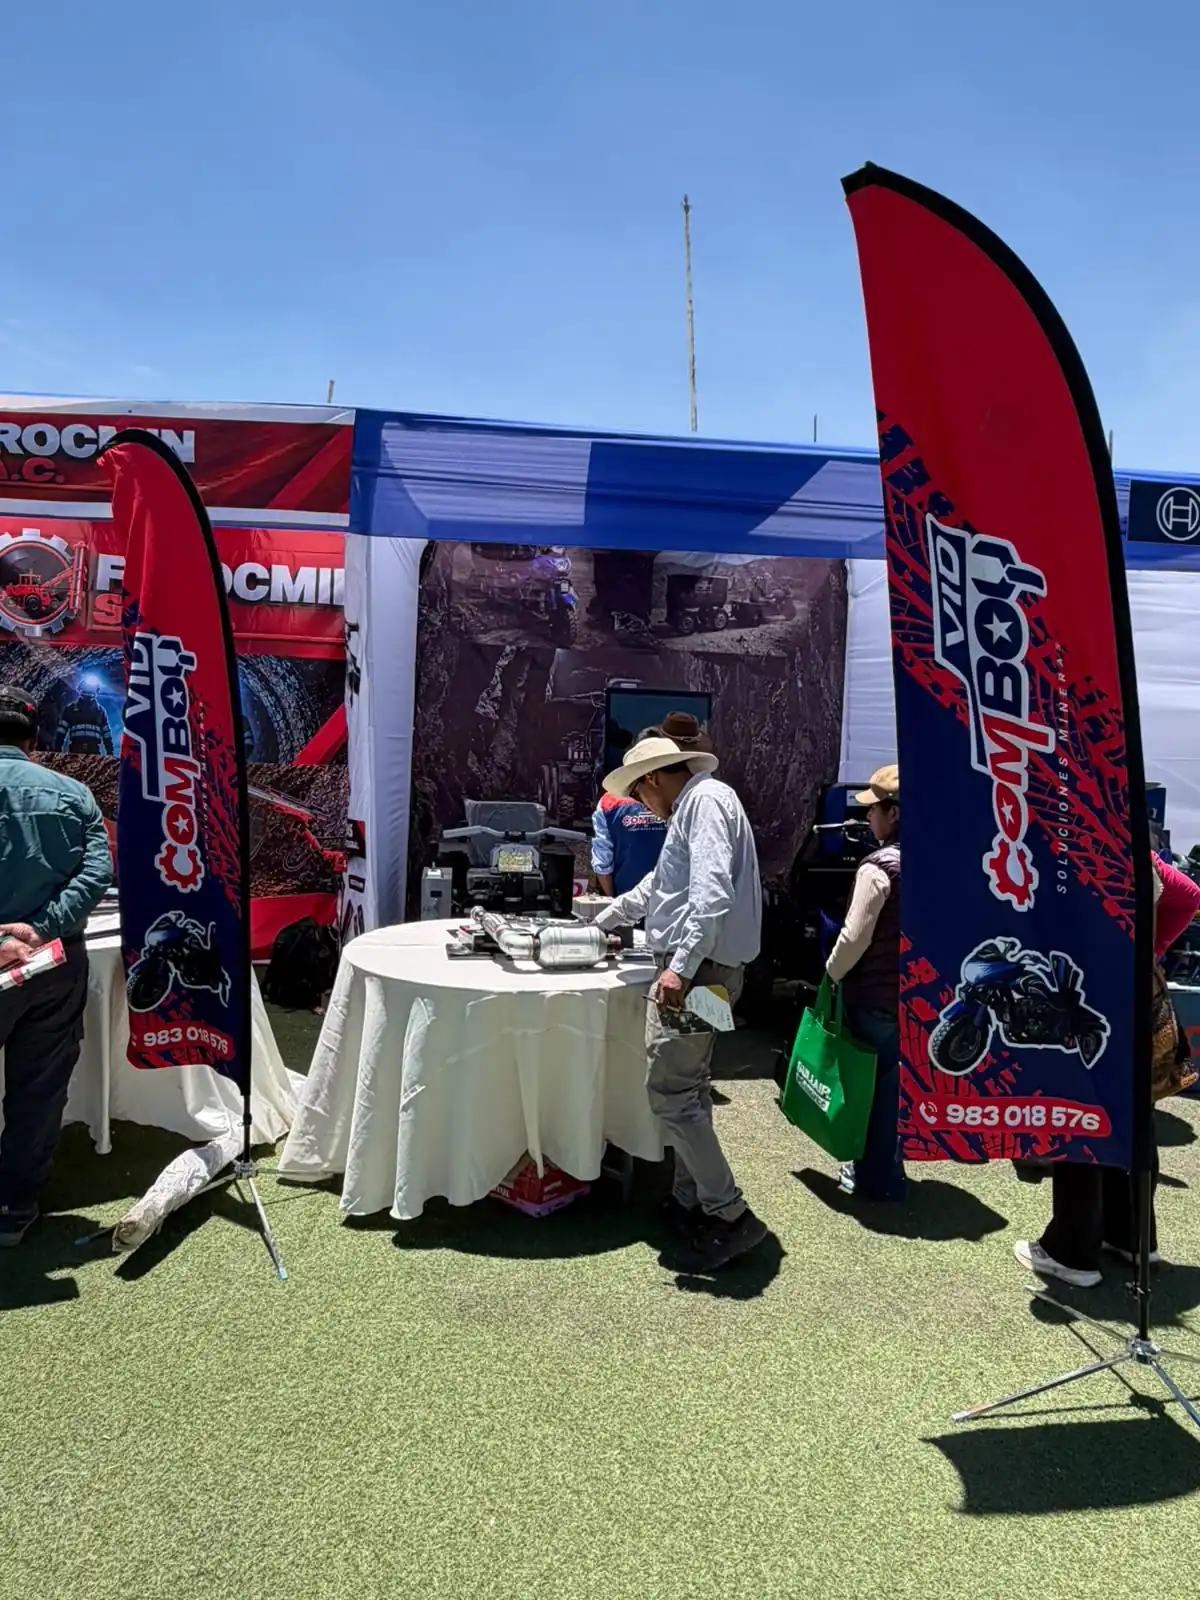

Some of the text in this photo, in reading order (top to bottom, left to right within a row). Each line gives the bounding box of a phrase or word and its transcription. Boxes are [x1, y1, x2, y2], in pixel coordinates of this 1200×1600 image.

[0, 422, 195, 463] ROCN
[936, 534, 965, 648] VID
[1056, 642, 1069, 894] SOLUCIONES MINERAS
[143, 1026, 229, 1054] 983 018 576
[946, 1104, 1101, 1130] 983 018 576
